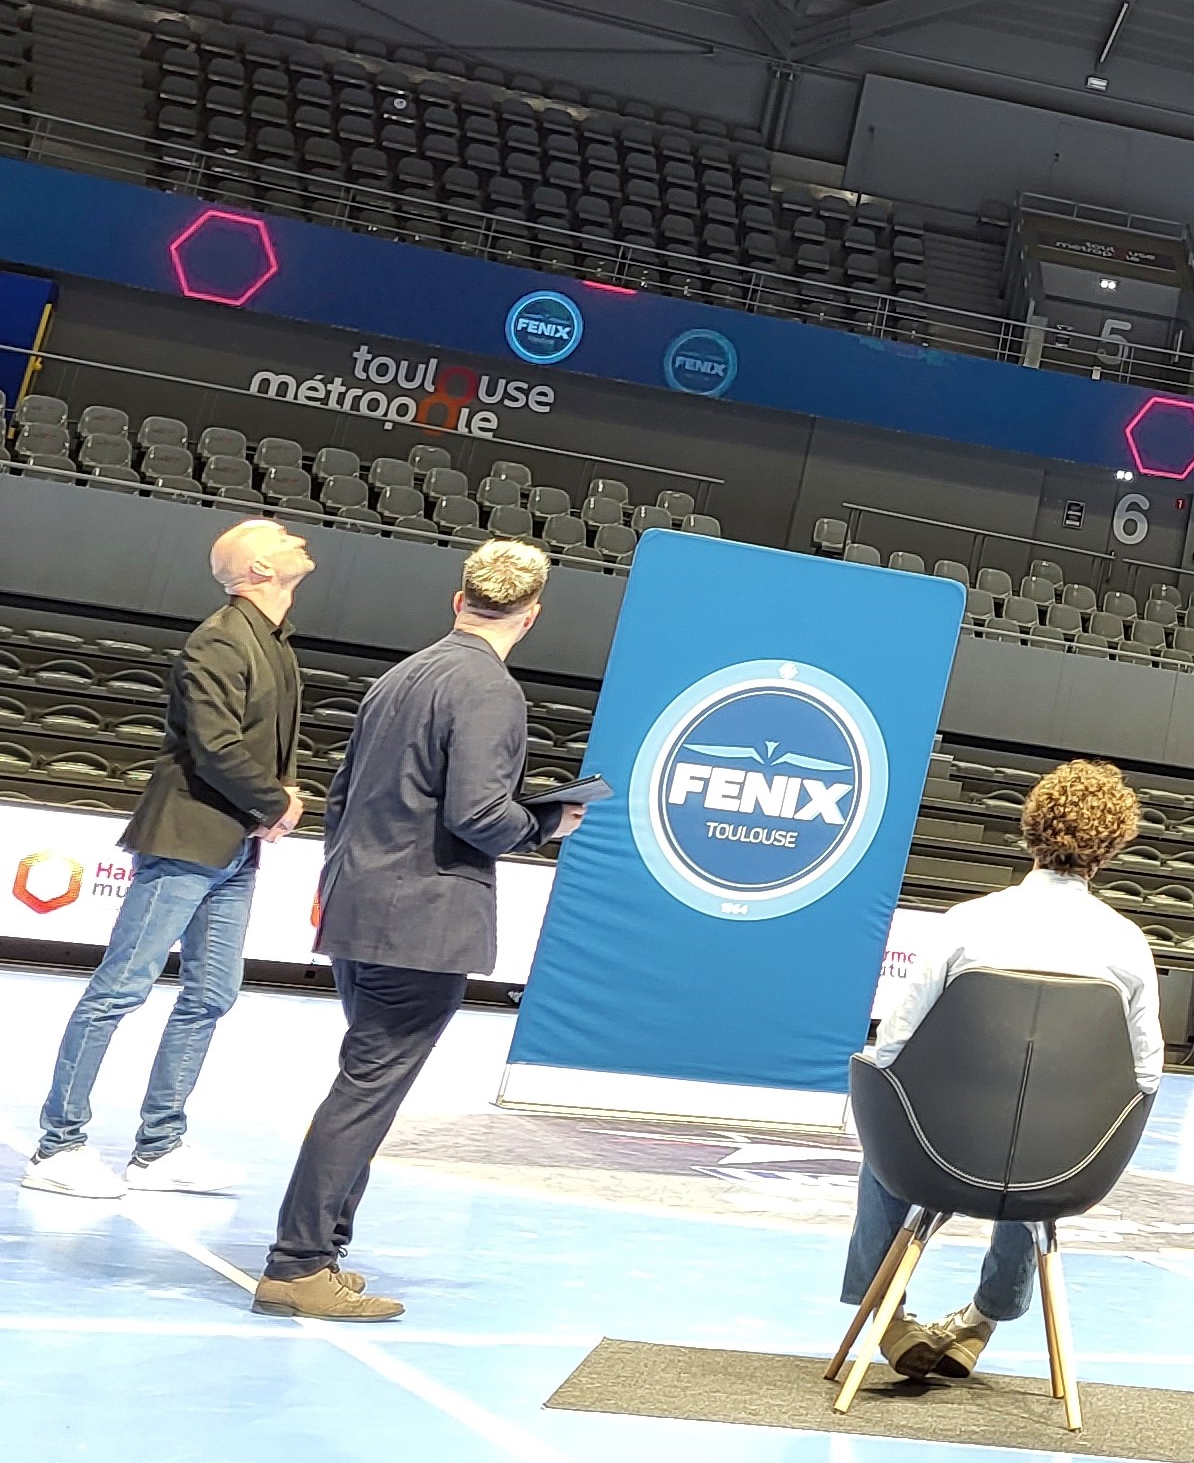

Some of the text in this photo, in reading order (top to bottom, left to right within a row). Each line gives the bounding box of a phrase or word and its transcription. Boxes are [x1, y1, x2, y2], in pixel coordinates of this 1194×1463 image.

[516, 318, 572, 340] FENIX
[1097, 318, 1132, 365] 5
[352, 345, 555, 413] toulouse
[675, 356, 726, 377] FENIX
[250, 370, 498, 438] métropole
[1113, 493, 1150, 545] 6
[668, 762, 853, 825] FENIX
[705, 821, 799, 848] TOULOUSE
